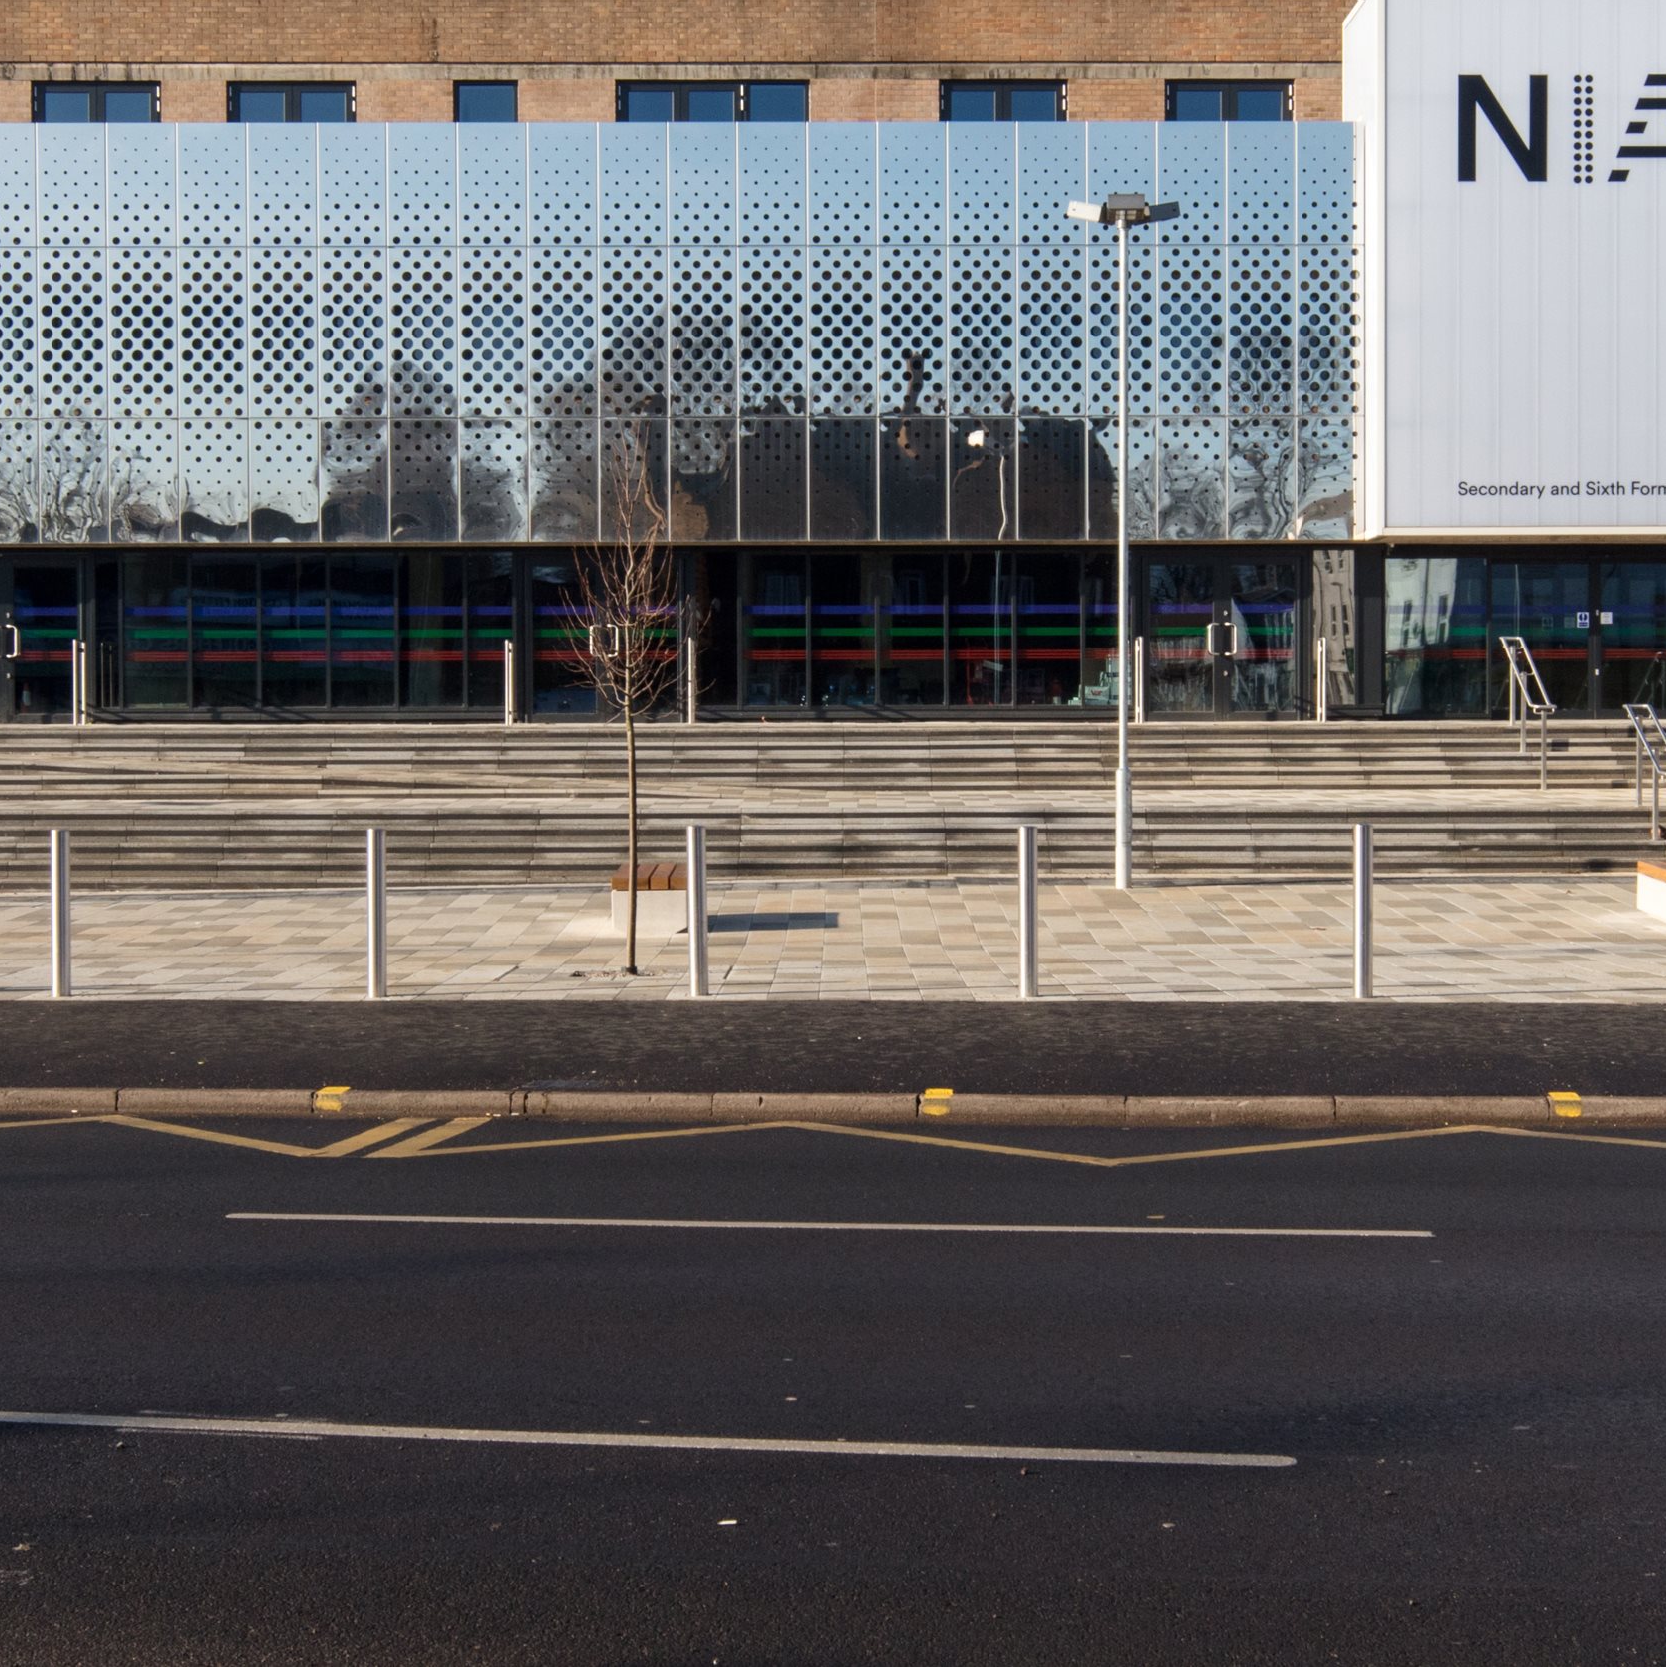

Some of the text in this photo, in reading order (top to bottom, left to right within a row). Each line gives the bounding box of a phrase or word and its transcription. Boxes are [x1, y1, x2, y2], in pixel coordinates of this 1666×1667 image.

[1457, 481, 1545, 499] Secondary
[1550, 481, 1580, 496] and
[1585, 481, 1625, 496] Sixth
